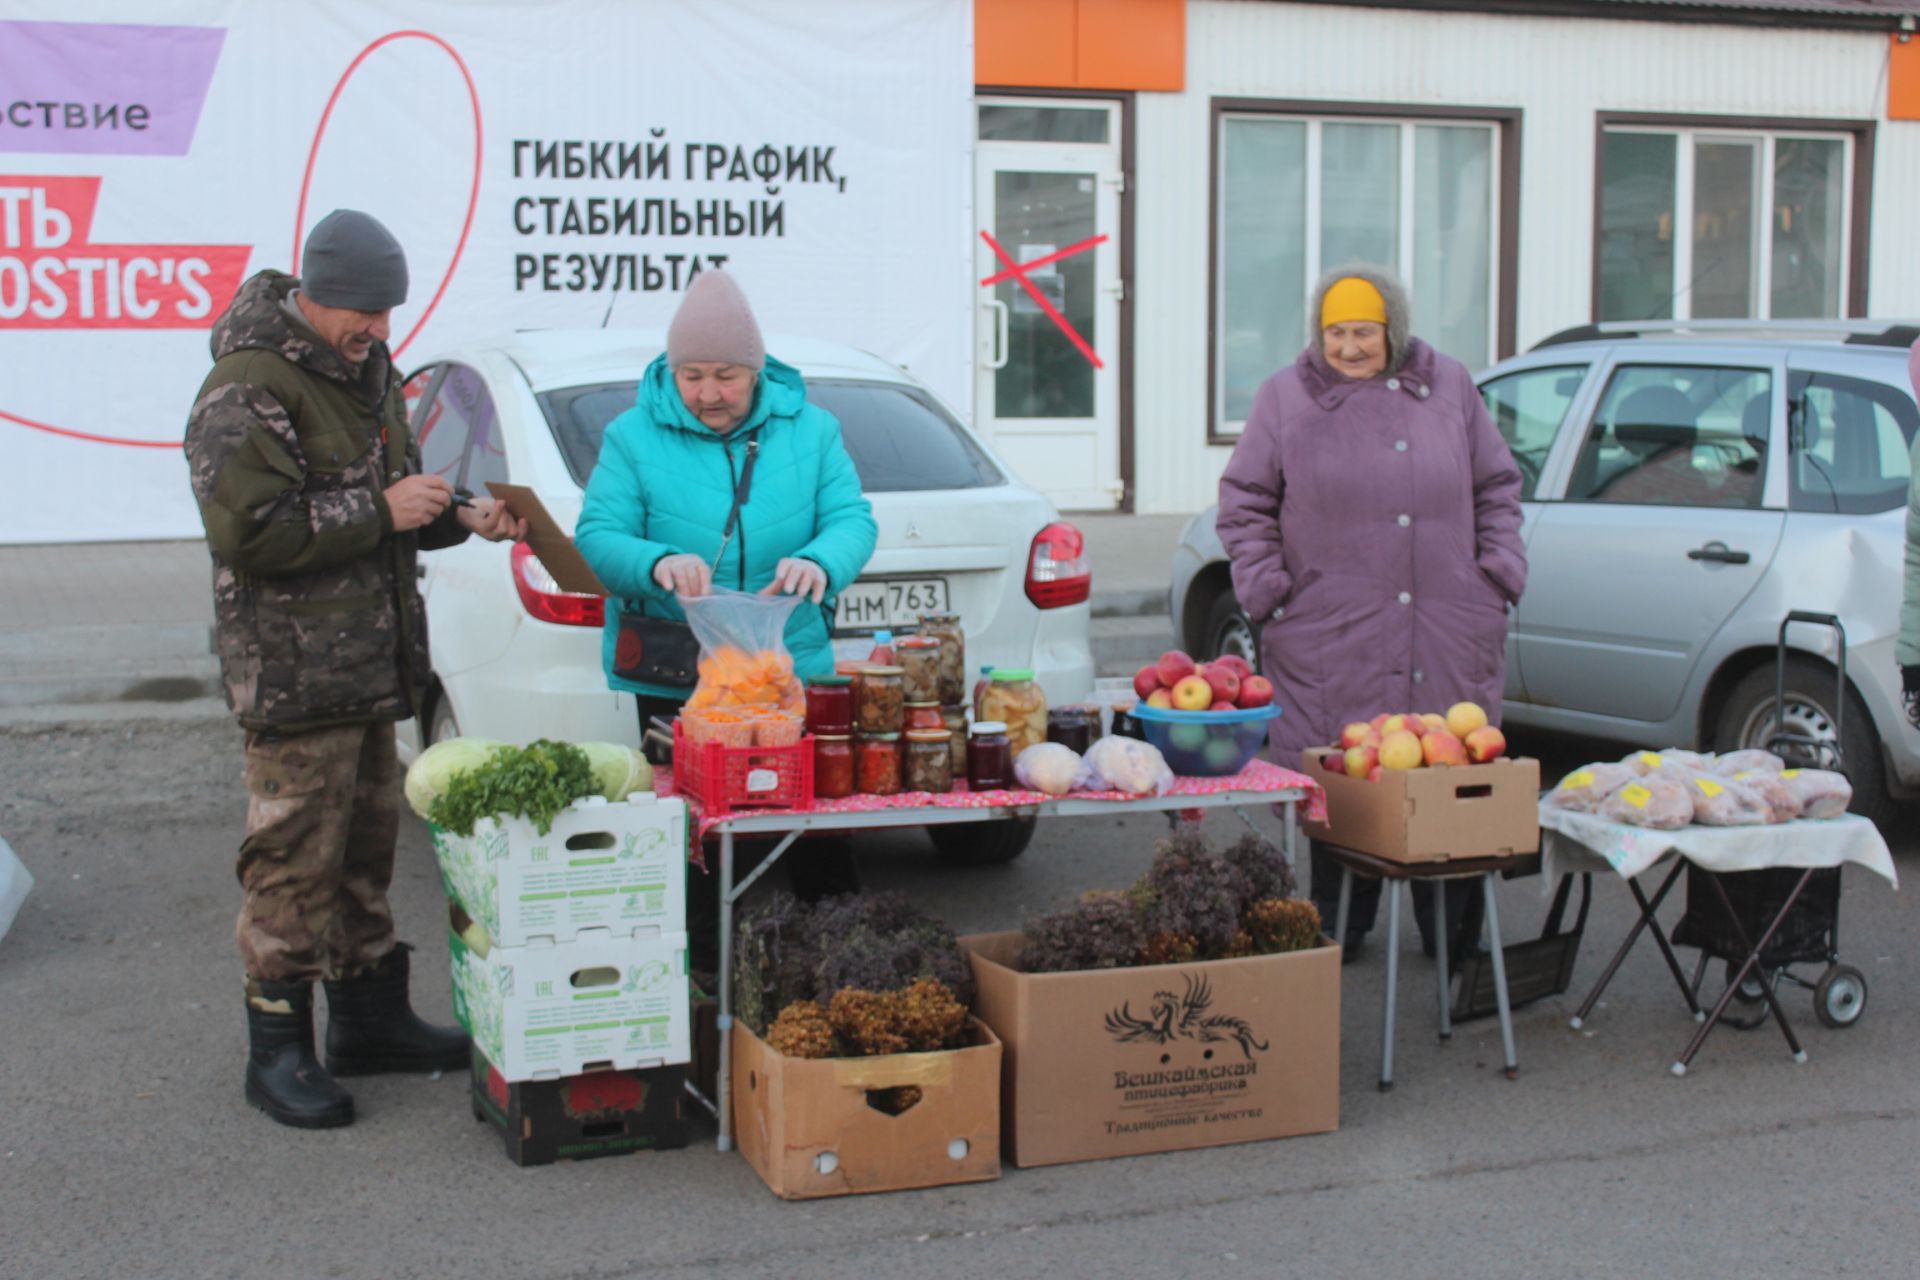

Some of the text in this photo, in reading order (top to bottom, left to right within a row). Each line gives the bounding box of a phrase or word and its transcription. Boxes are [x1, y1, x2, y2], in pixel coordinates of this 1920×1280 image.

[0, 101, 151, 131] ствие
[513, 128, 847, 193] ГИБКИЙ ГРАФИК,
[513, 186, 786, 237] СТАБИЛЬНЫЙ
[0, 256, 212, 320] OSTIC'S
[889, 585, 938, 611] 763
[1113, 1062, 1258, 1089] Вешкаймская
